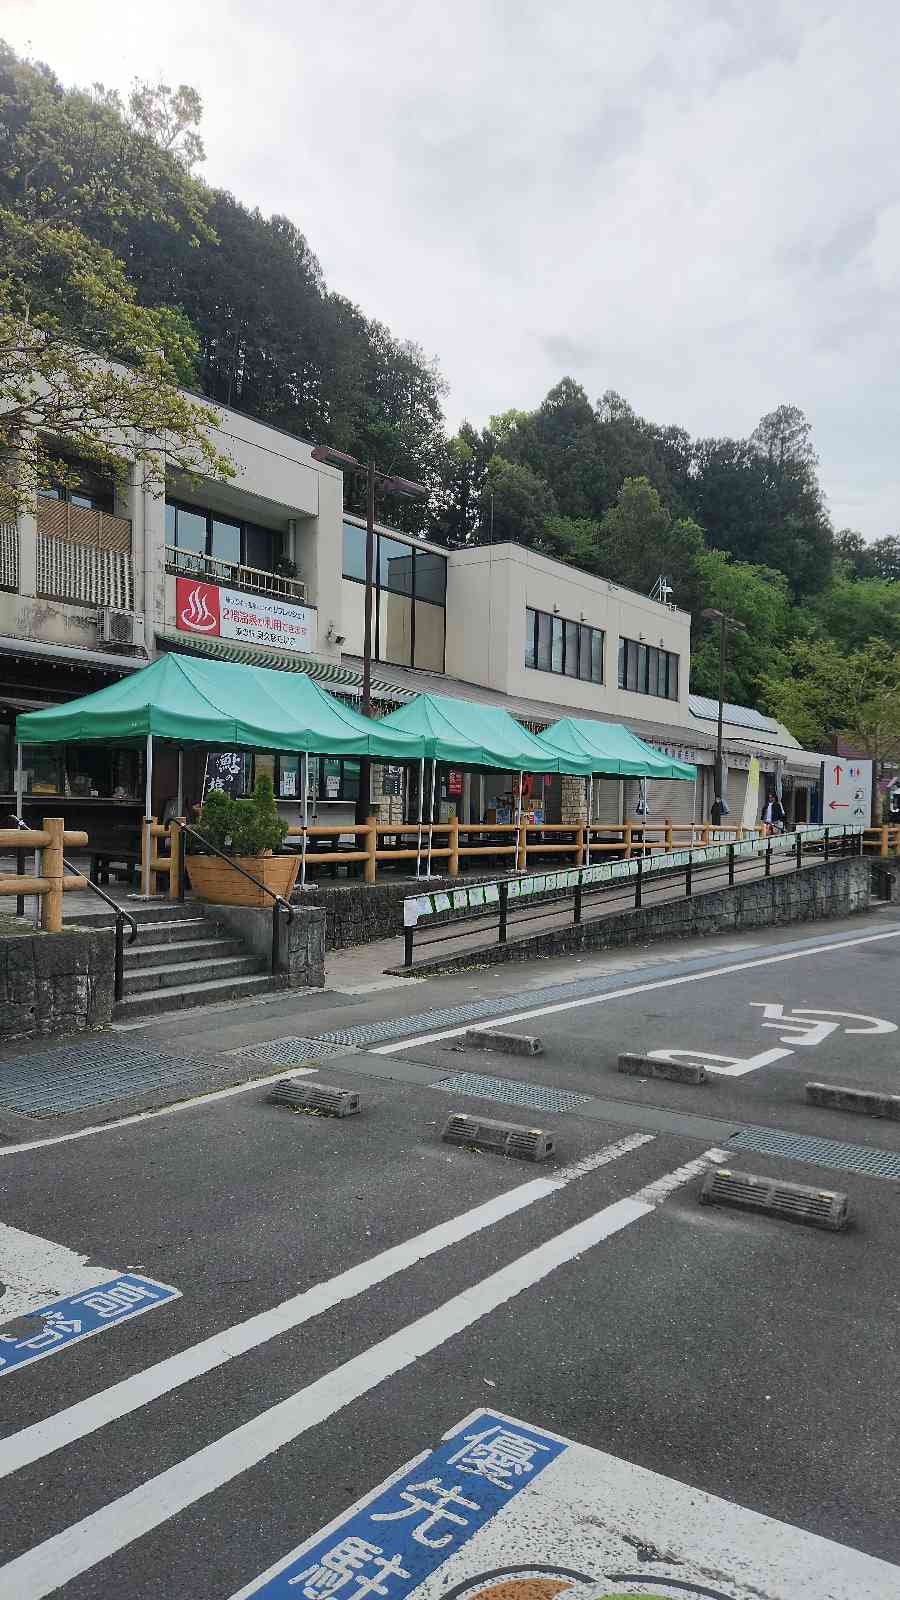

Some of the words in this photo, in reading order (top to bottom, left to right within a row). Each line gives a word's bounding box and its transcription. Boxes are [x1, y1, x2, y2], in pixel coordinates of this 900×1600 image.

[0, 1282, 161, 1366] 高齢
[287, 1424, 552, 1600] 優先駐
